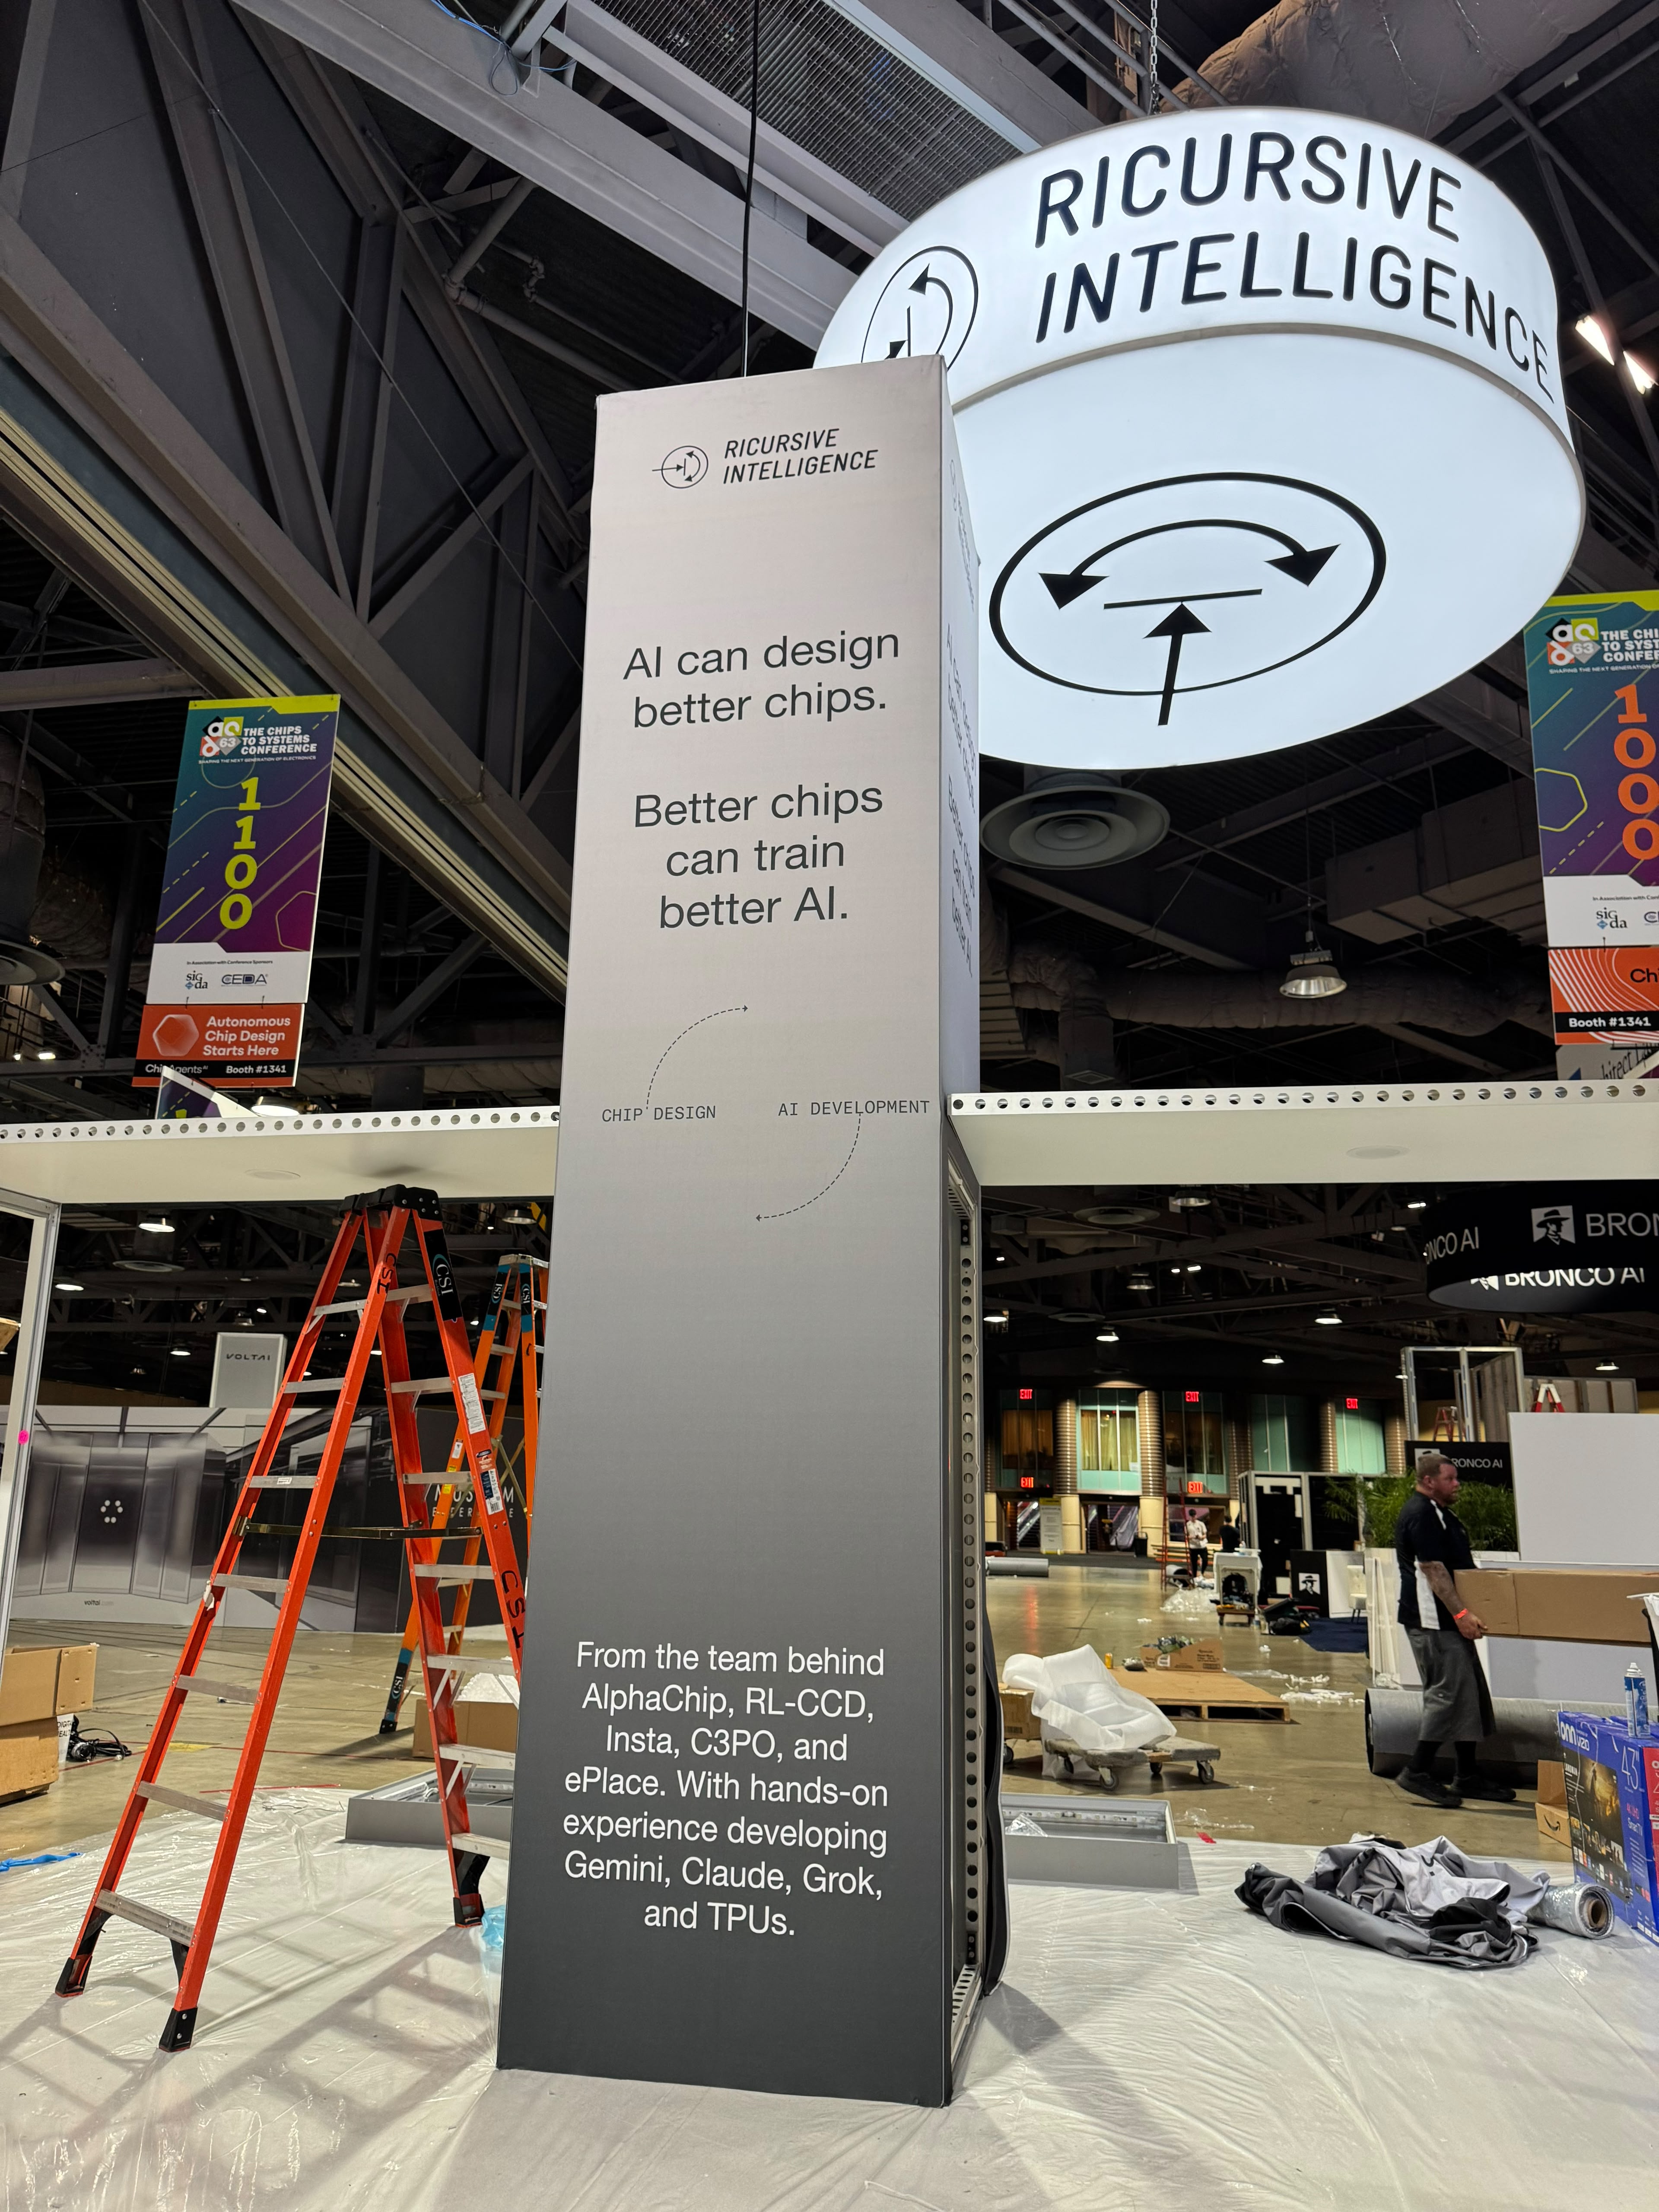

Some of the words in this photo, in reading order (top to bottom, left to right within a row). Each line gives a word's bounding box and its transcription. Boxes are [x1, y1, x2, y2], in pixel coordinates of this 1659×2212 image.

[1035, 132, 1462, 248] RICURSIVE
[1036, 232, 1555, 403] INTELLIGENCE
[725, 429, 839, 458] RICURSIVE
[723, 450, 878, 484] INTELLIGENCE
[1600, 630, 1629, 640] THE
[623, 646, 661, 680] AI
[677, 647, 747, 675] can
[763, 630, 899, 669] design
[1572, 642, 1594, 654] 63
[1602, 641, 1621, 652] TO
[634, 693, 751, 728] better
[765, 682, 886, 722] chips.
[242, 737, 256, 745] TO
[259, 735, 310, 745] SYSTEMS
[244, 728, 264, 736] THE
[267, 726, 302, 735] CHIPS
[219, 738, 235, 748] 63
[241, 744, 317, 755] CONFERENCE
[635, 792, 757, 827] Better
[771, 782, 883, 823] chips
[666, 848, 738, 876] can
[754, 835, 844, 871] train
[660, 893, 782, 928] better
[794, 886, 847, 922] AI.
[222, 974, 267, 984] CEDA
[207, 1016, 291, 1027] Autonomous
[1569, 1017, 1606, 1027] Booth
[1608, 1017, 1651, 1027] #1341
[205, 1030, 237, 1043] Chip
[240, 1030, 286, 1043] Design
[203, 1045, 244, 1056] Starts
[248, 1045, 279, 1056] Here
[255, 1065, 286, 1074] #1341
[602, 1108, 643, 1122] CHIP
[654, 1106, 716, 1120] DESIGN
[778, 1103, 798, 1116] AI
[811, 1100, 930, 1115] DEVELOPMENT
[1460, 1226, 1479, 1252] AI
[436, 1264, 453, 1296] CSI
[493, 1284, 502, 1299] CSI
[1020, 1389, 1033, 1399] EXIT
[1185, 1392, 1199, 1402] EXIT
[1452, 1458, 1491, 1468] RONCO
[1492, 1459, 1503, 1468] AI
[577, 1641, 646, 1669] From
[656, 1643, 699, 1670] the
[708, 1645, 777, 1672] team
[788, 1646, 884, 1675] behind
[394, 1676, 403, 1694] CSI
[582, 1682, 734, 1719] AlphaChip,
[746, 1687, 873, 1723] RL-CCD,
[607, 1725, 680, 1758] Insta,
[691, 1727, 782, 1762] C3PO,
[794, 1734, 847, 1761] and
[565, 1766, 665, 1796] ePlace.
[677, 1770, 739, 1799] With
[750, 1773, 888, 1806] hands-on
[563, 1812, 718, 1842] experience
[727, 1816, 887, 1858] developing
[565, 1851, 671, 1888] Gemini,
[682, 1856, 791, 1894] Claude,
[803, 1863, 882, 1901] Grok,
[644, 1901, 697, 1929] and
[707, 1902, 795, 1935] TPUs.
